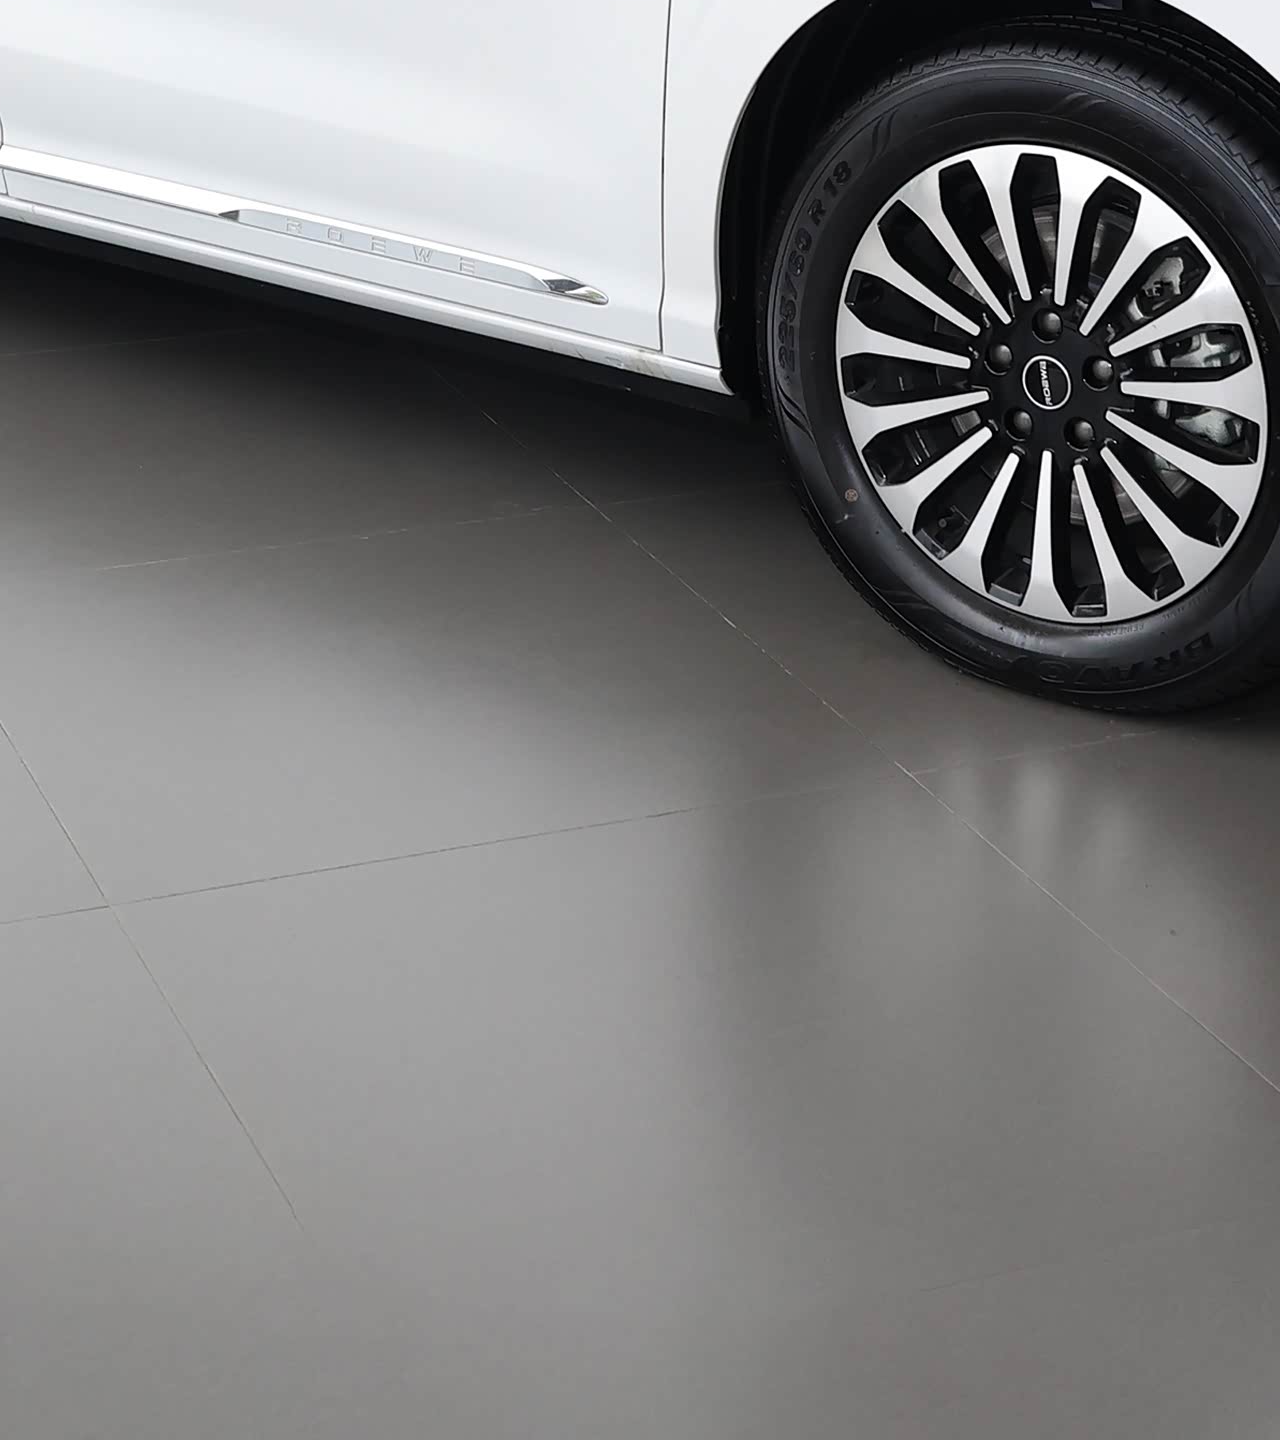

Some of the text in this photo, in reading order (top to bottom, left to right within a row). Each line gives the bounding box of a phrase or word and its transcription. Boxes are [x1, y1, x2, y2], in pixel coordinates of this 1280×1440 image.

[285, 216, 477, 275] ROEWE
[777, 227, 812, 373] 225/60
[1038, 360, 1054, 406] ROEWE
